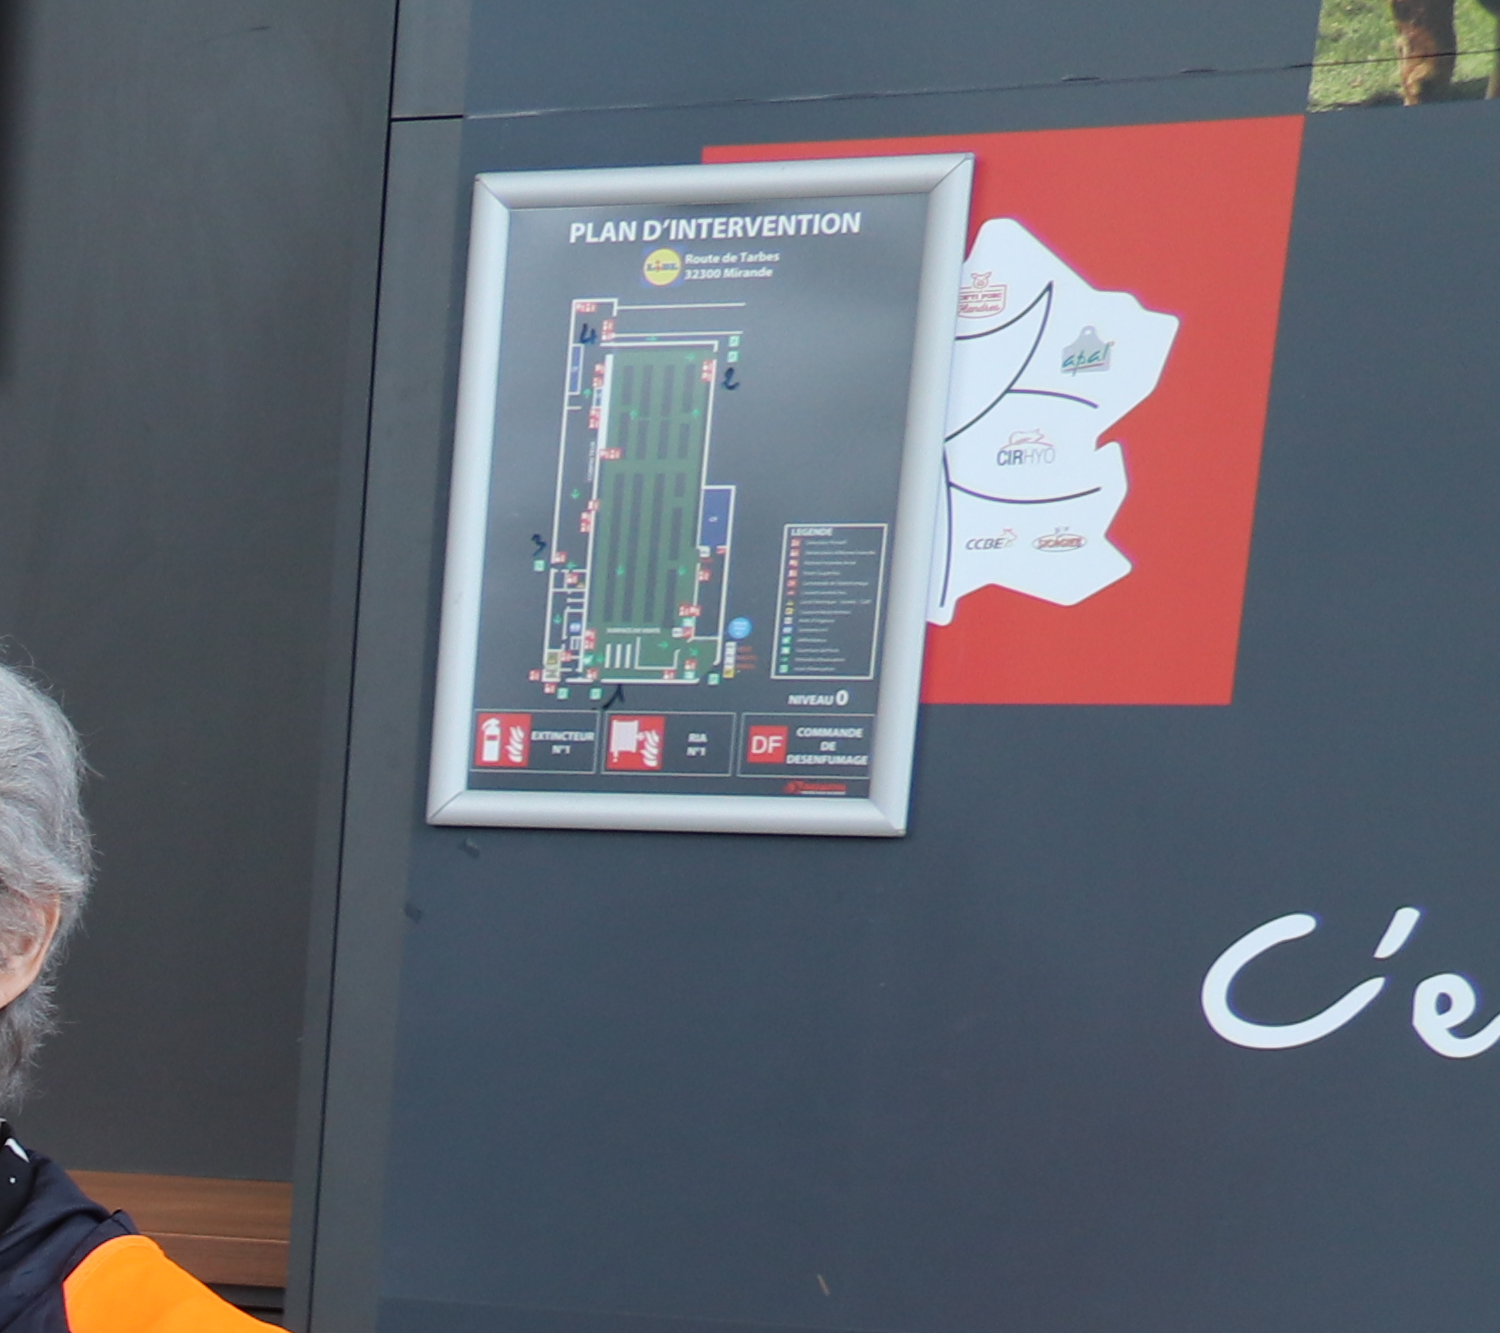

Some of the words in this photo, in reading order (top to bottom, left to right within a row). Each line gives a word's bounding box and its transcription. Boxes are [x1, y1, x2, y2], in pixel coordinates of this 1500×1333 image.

[569, 220, 636, 243] PLAN
[642, 212, 862, 242] D'INTERVENTION
[684, 253, 721, 265] Route
[722, 252, 738, 264] de
[740, 251, 780, 264] Tarbes
[684, 268, 722, 281] 32300
[723, 266, 774, 279] Mirande
[1062, 344, 1110, 377] apal
[996, 448, 1056, 466] CIRHYO
[788, 695, 834, 706] NIVEAU
[531, 730, 595, 742] EXTINCTEUR
[750, 735, 784, 754] DF
[796, 727, 863, 739] COMMANDE
[819, 740, 837, 752] DE
